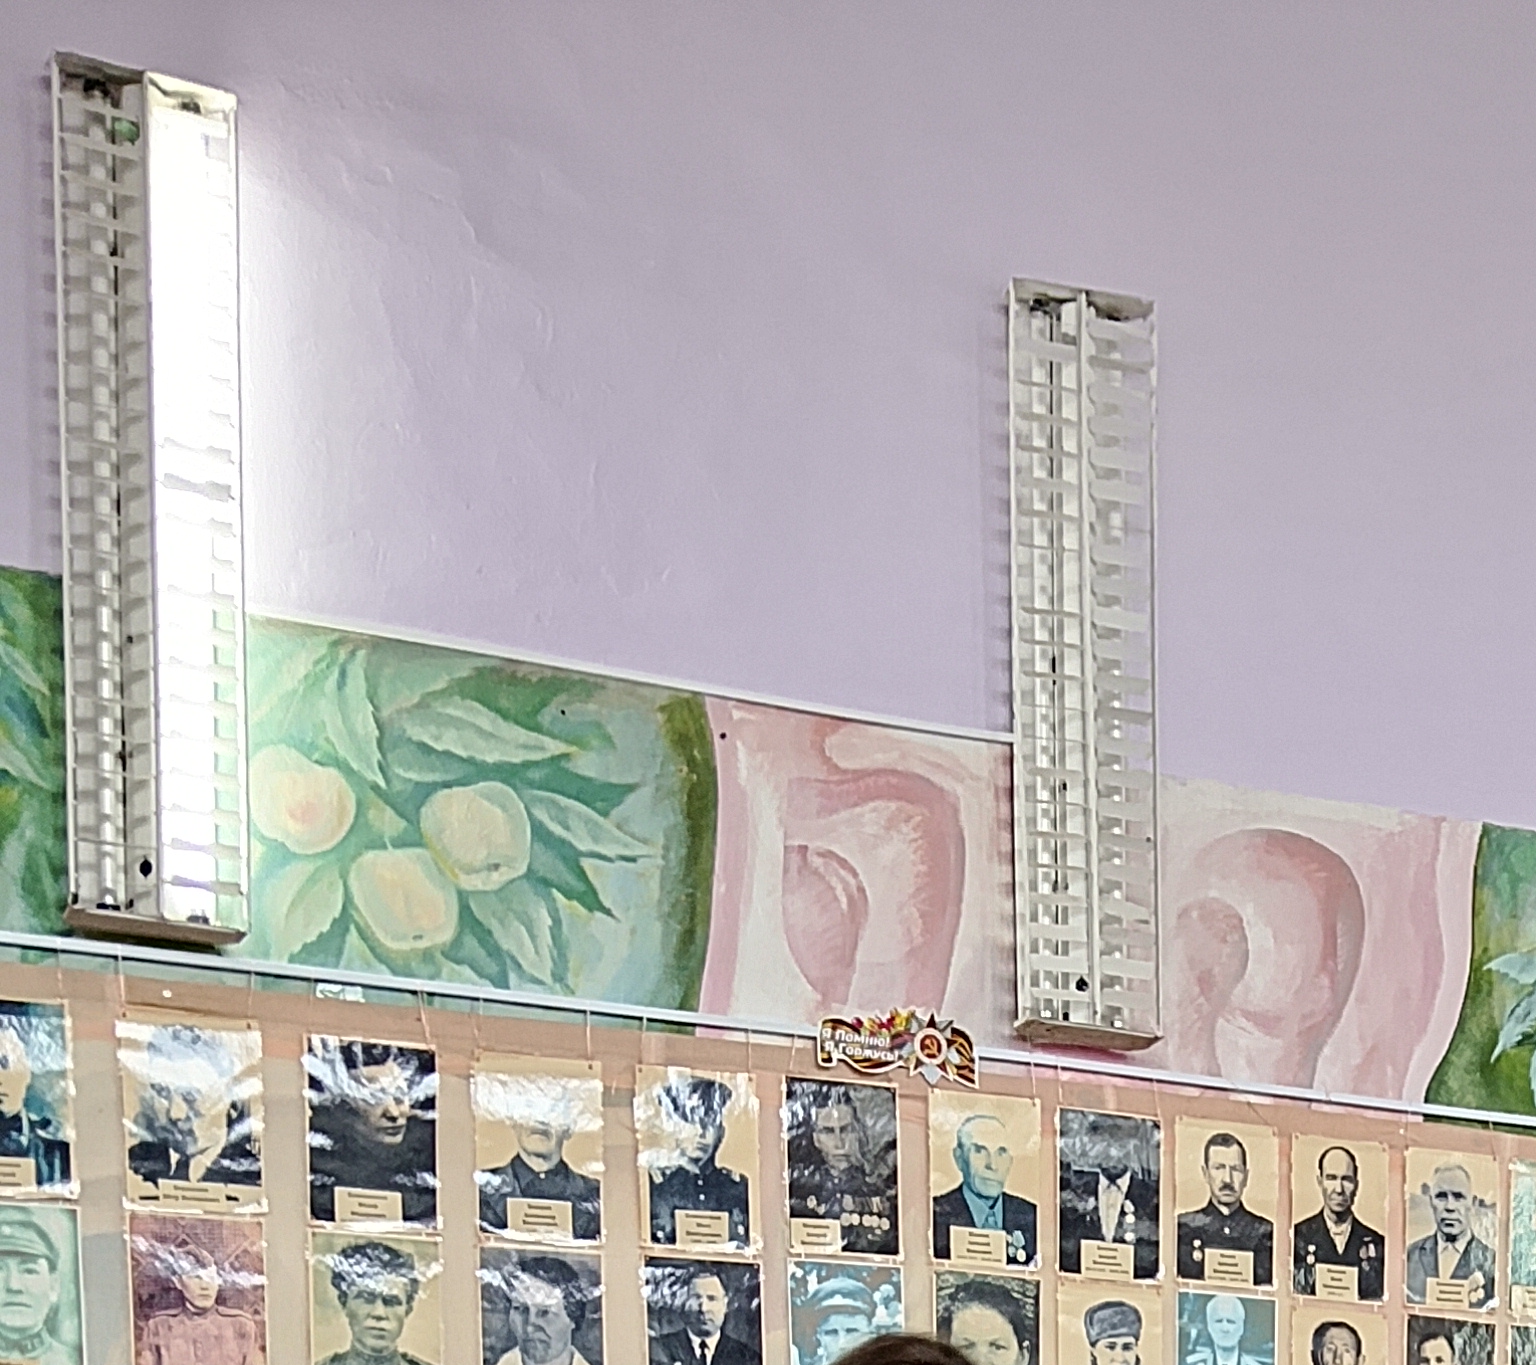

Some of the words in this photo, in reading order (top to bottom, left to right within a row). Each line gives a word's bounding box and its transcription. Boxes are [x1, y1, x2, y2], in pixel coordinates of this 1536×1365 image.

[822, 1028, 832, 1038] Я
[835, 1029, 890, 1047] Помню!
[825, 1041, 834, 1051] Я
[839, 1043, 899, 1061] Горжусь!
